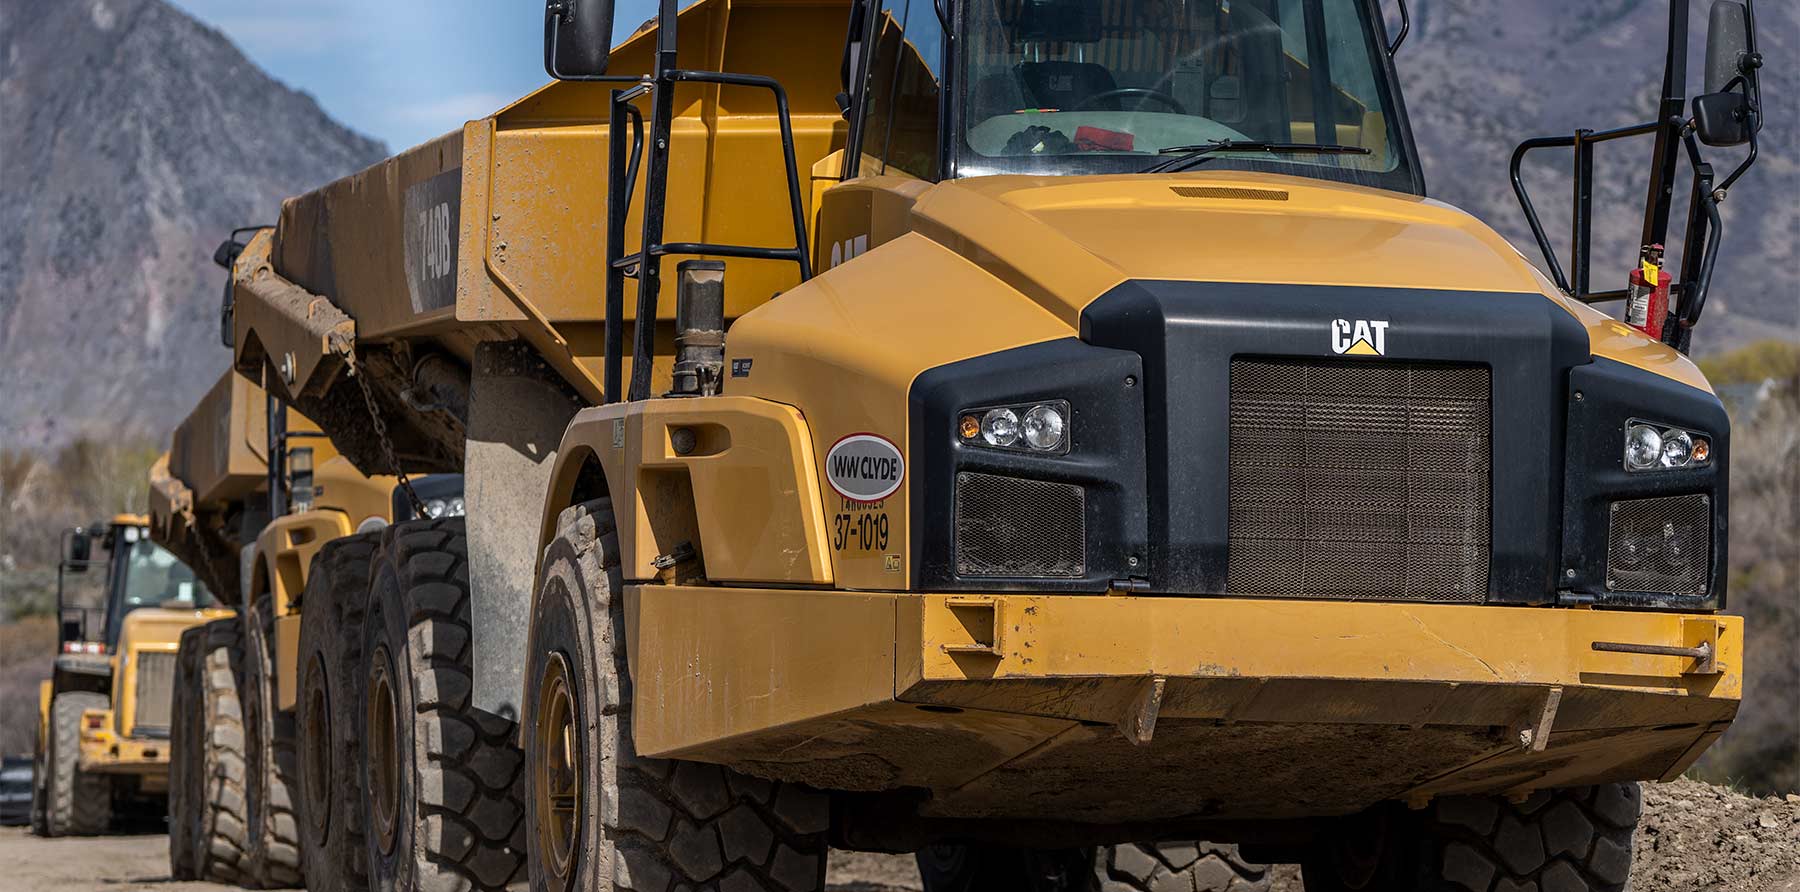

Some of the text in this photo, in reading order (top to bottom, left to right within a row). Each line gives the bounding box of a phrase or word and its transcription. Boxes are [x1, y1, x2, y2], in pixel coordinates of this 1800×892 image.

[419, 202, 450, 281] 740B
[1331, 318, 1389, 356] CAT
[833, 455, 897, 481] WW CLYDE
[834, 513, 889, 551] 37-1019
